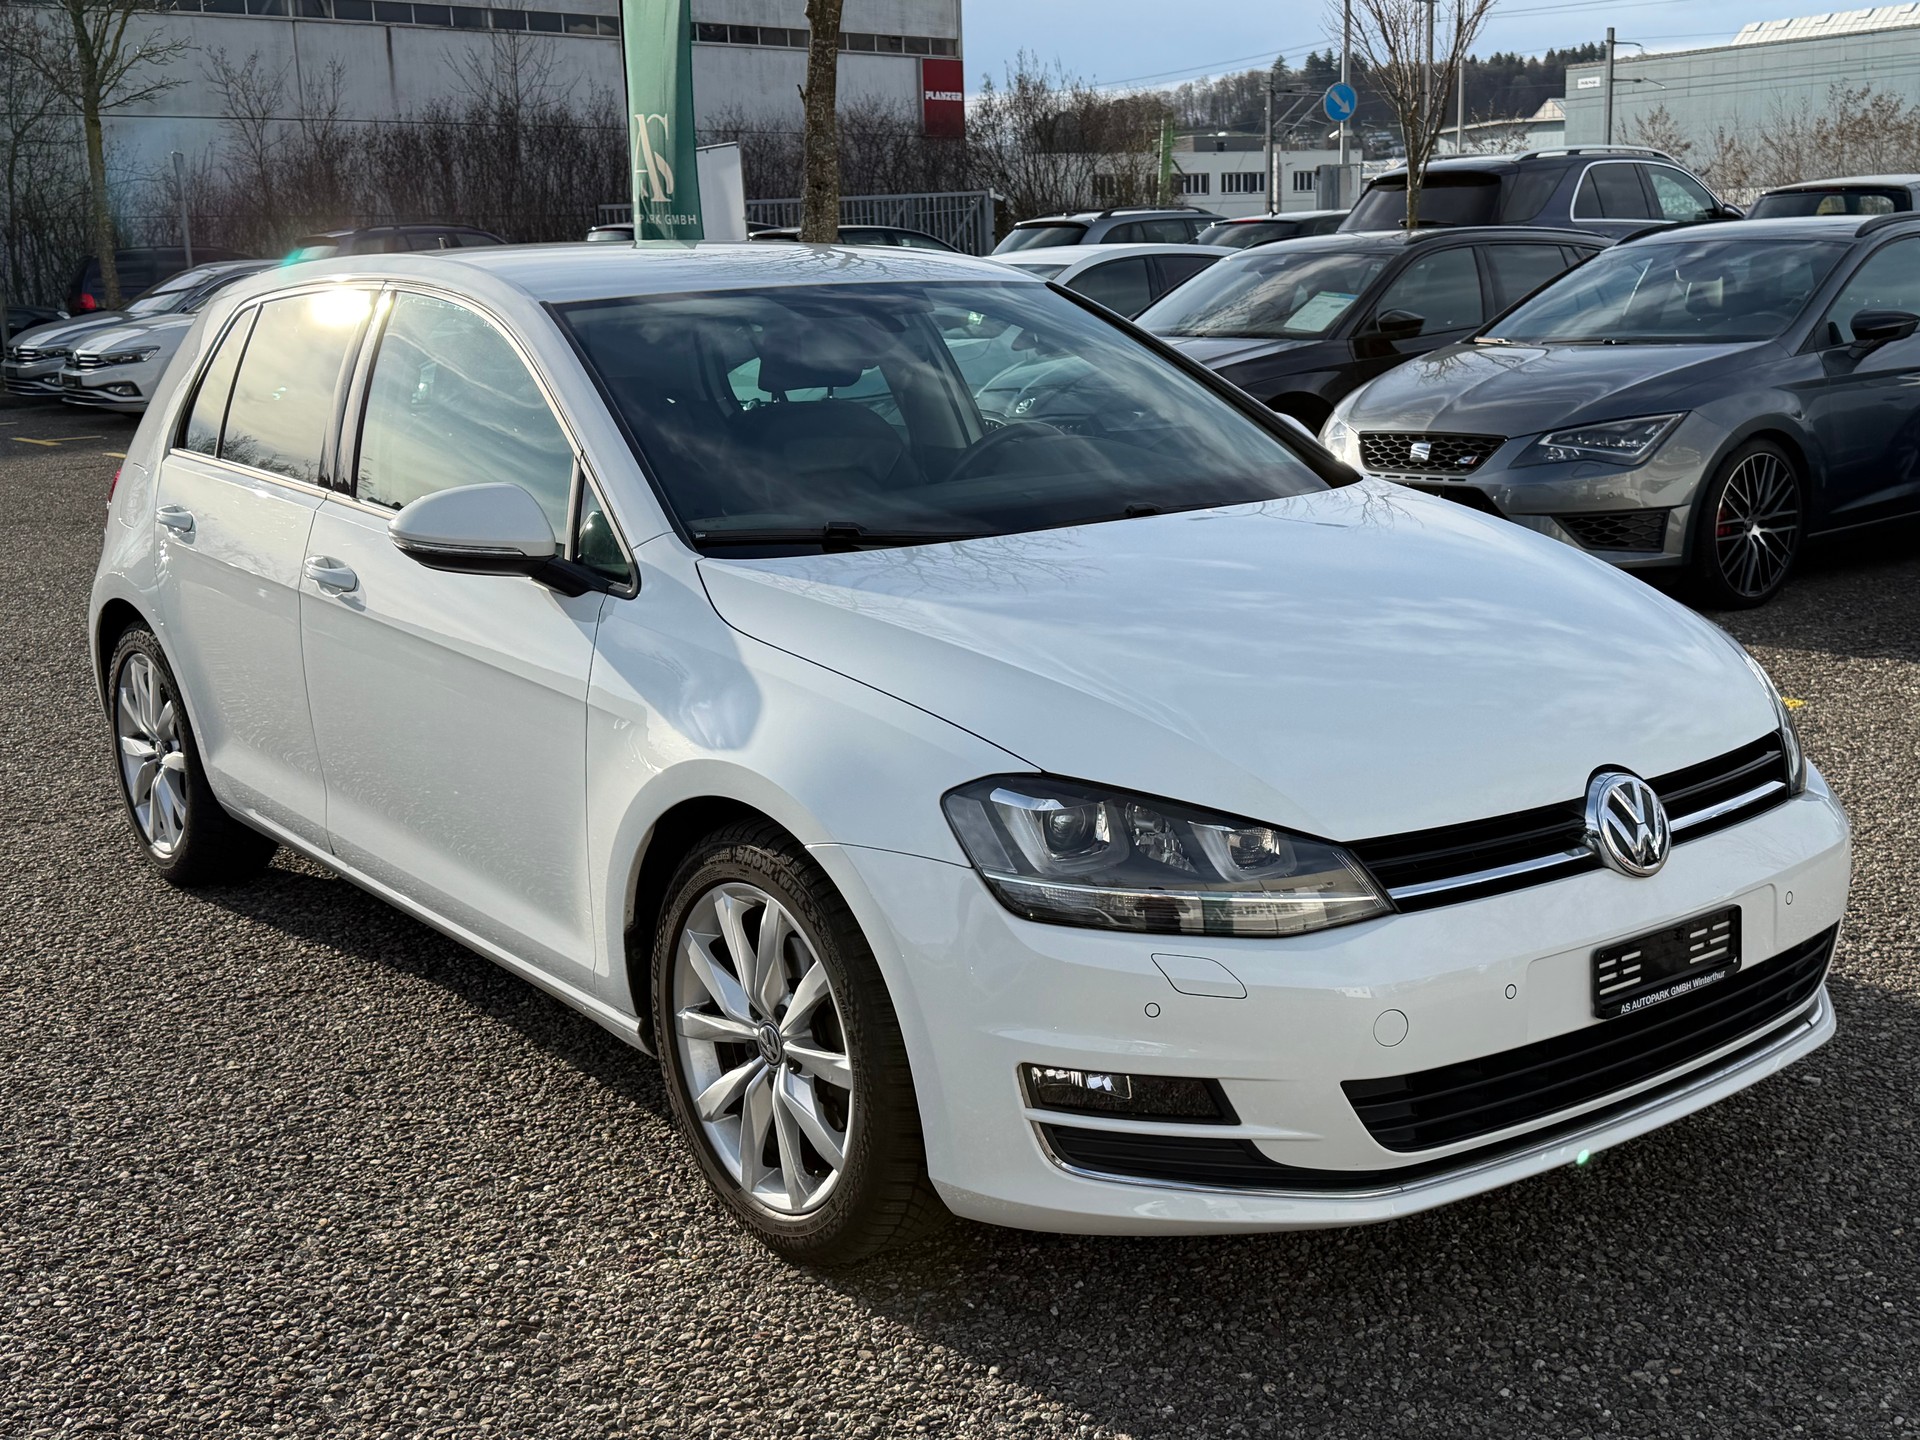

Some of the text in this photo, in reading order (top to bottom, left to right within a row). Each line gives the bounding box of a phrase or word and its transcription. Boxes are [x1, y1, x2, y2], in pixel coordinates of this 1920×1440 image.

[925, 91, 963, 102] PLANZER
[664, 214, 697, 225] GMBH
[1620, 971, 1726, 1014] AS AUTOPARK GMBH Winterthur
